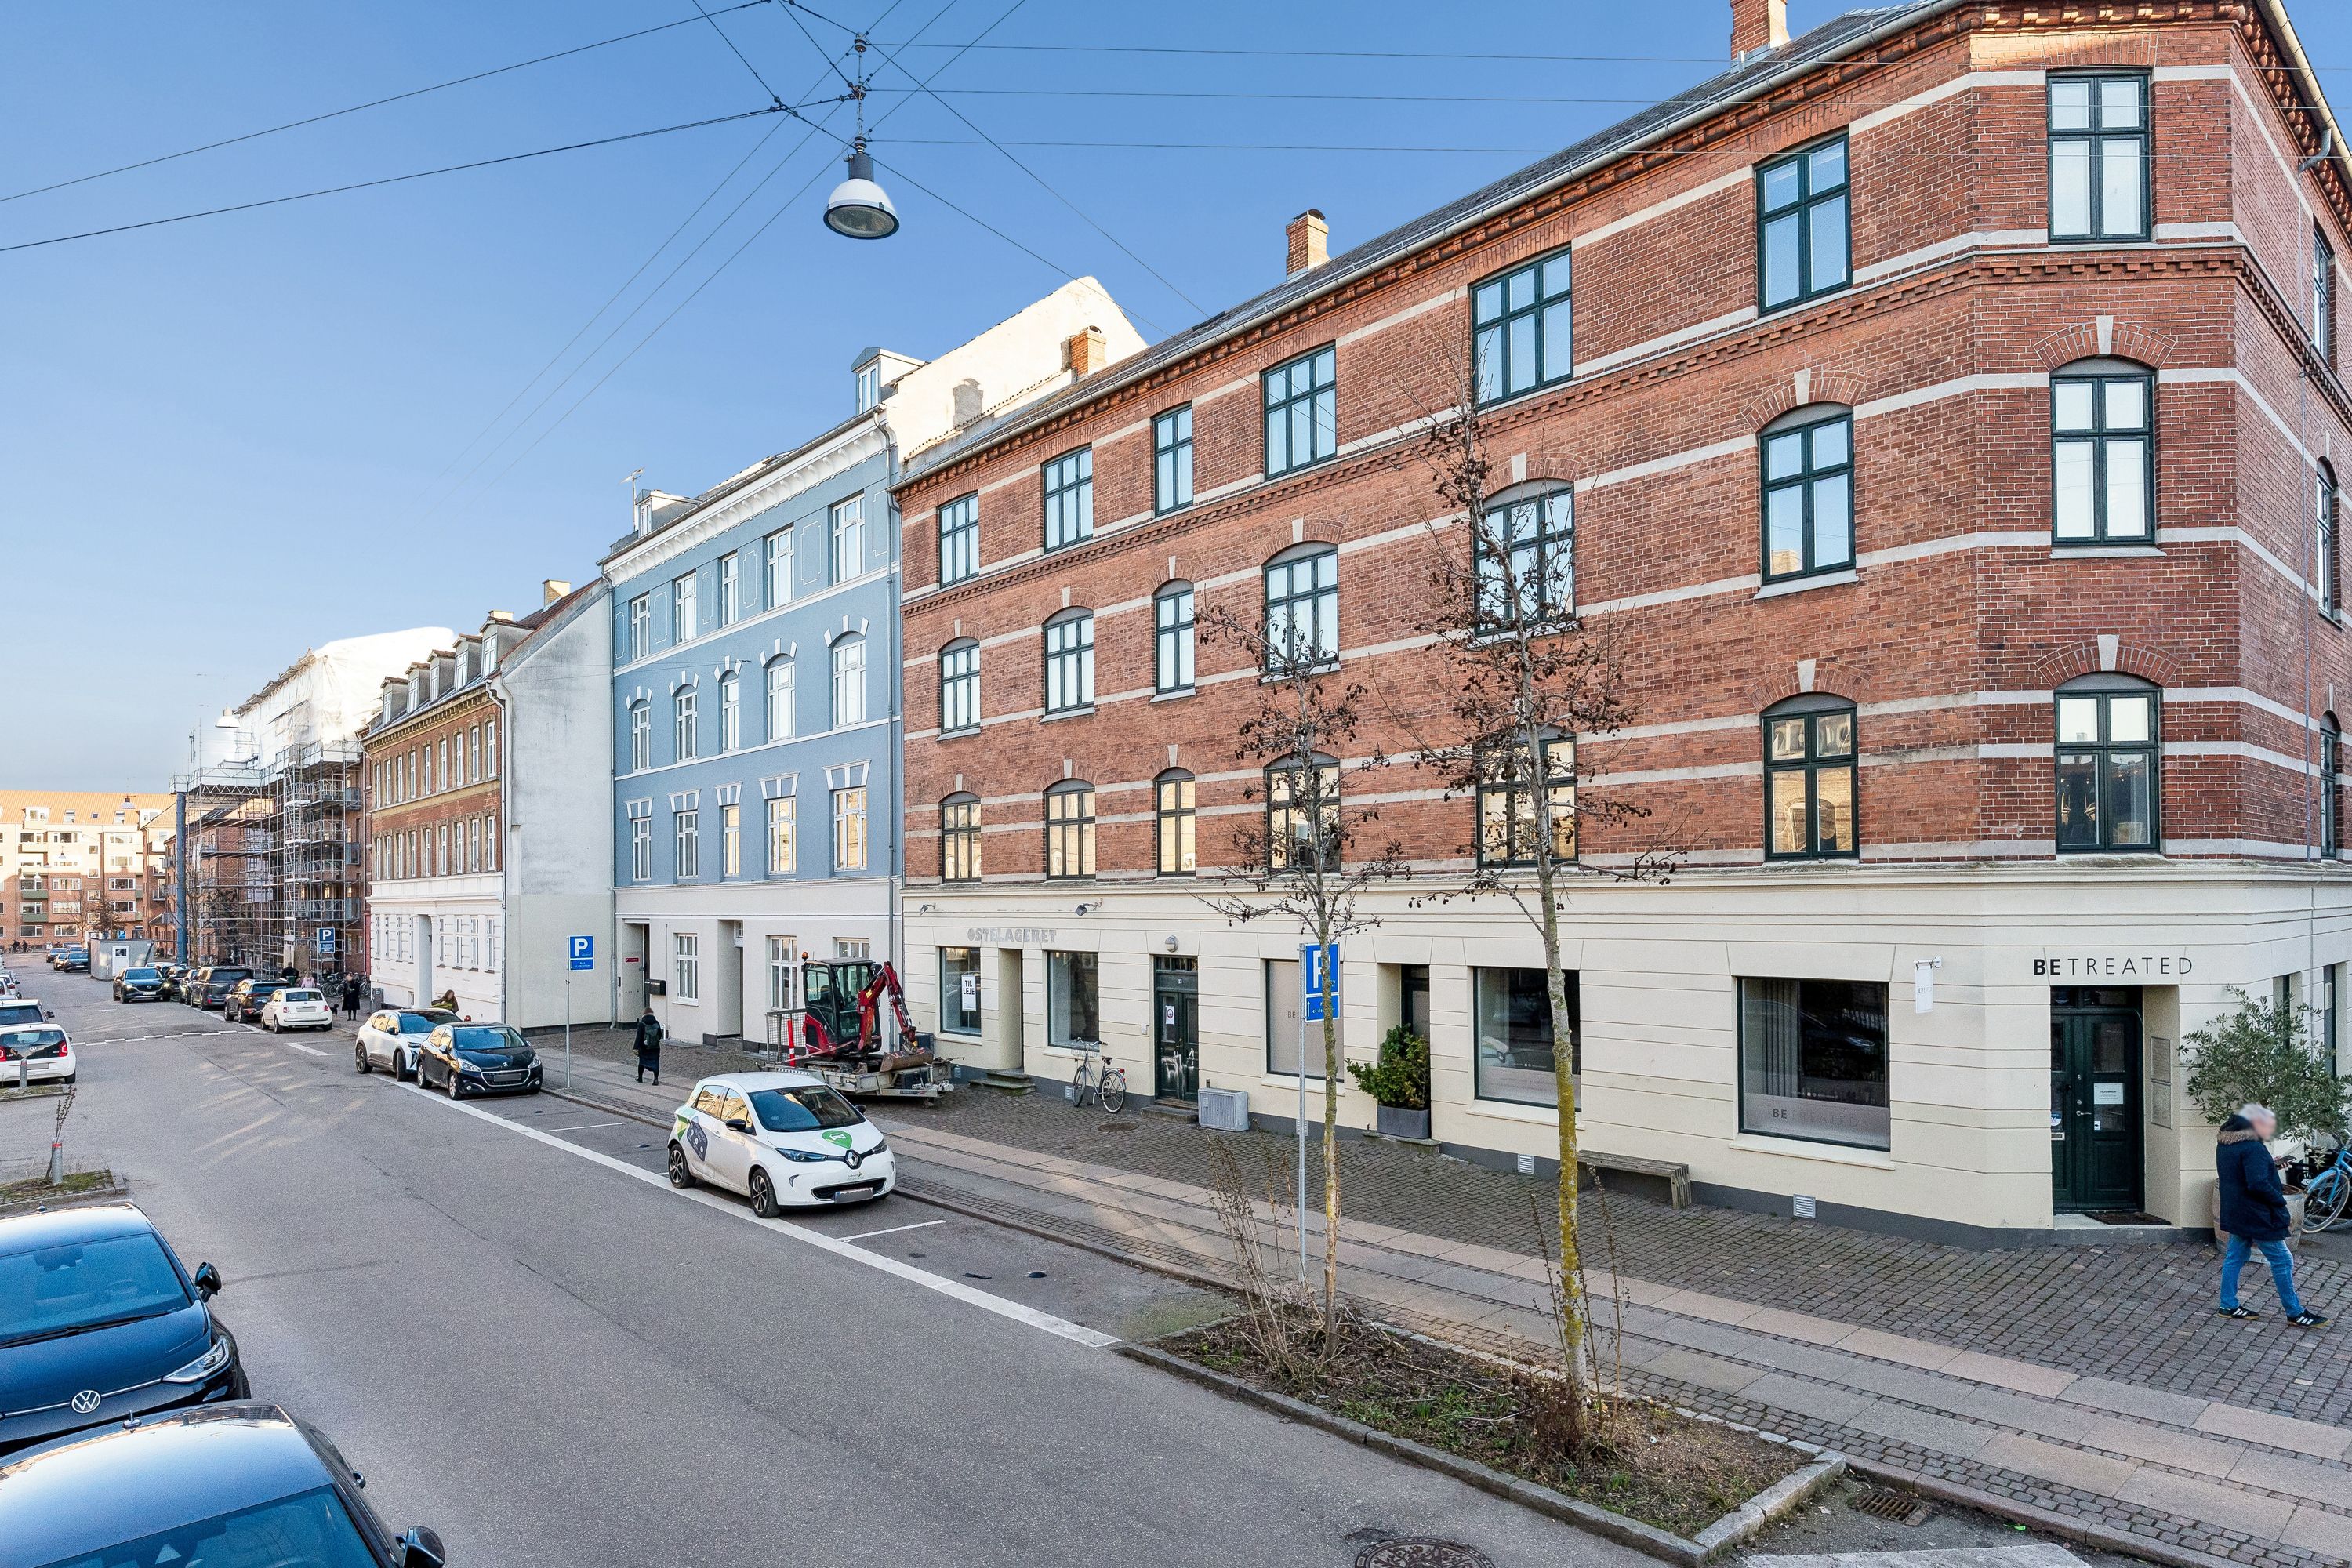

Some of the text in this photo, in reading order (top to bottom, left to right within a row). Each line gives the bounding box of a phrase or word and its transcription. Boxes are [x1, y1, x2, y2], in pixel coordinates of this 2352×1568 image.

[322, 929, 332, 941] P
[967, 927, 1057, 943] OSTELAGERET
[575, 938, 588, 956] P
[2033, 957, 2193, 975] BETREATED
